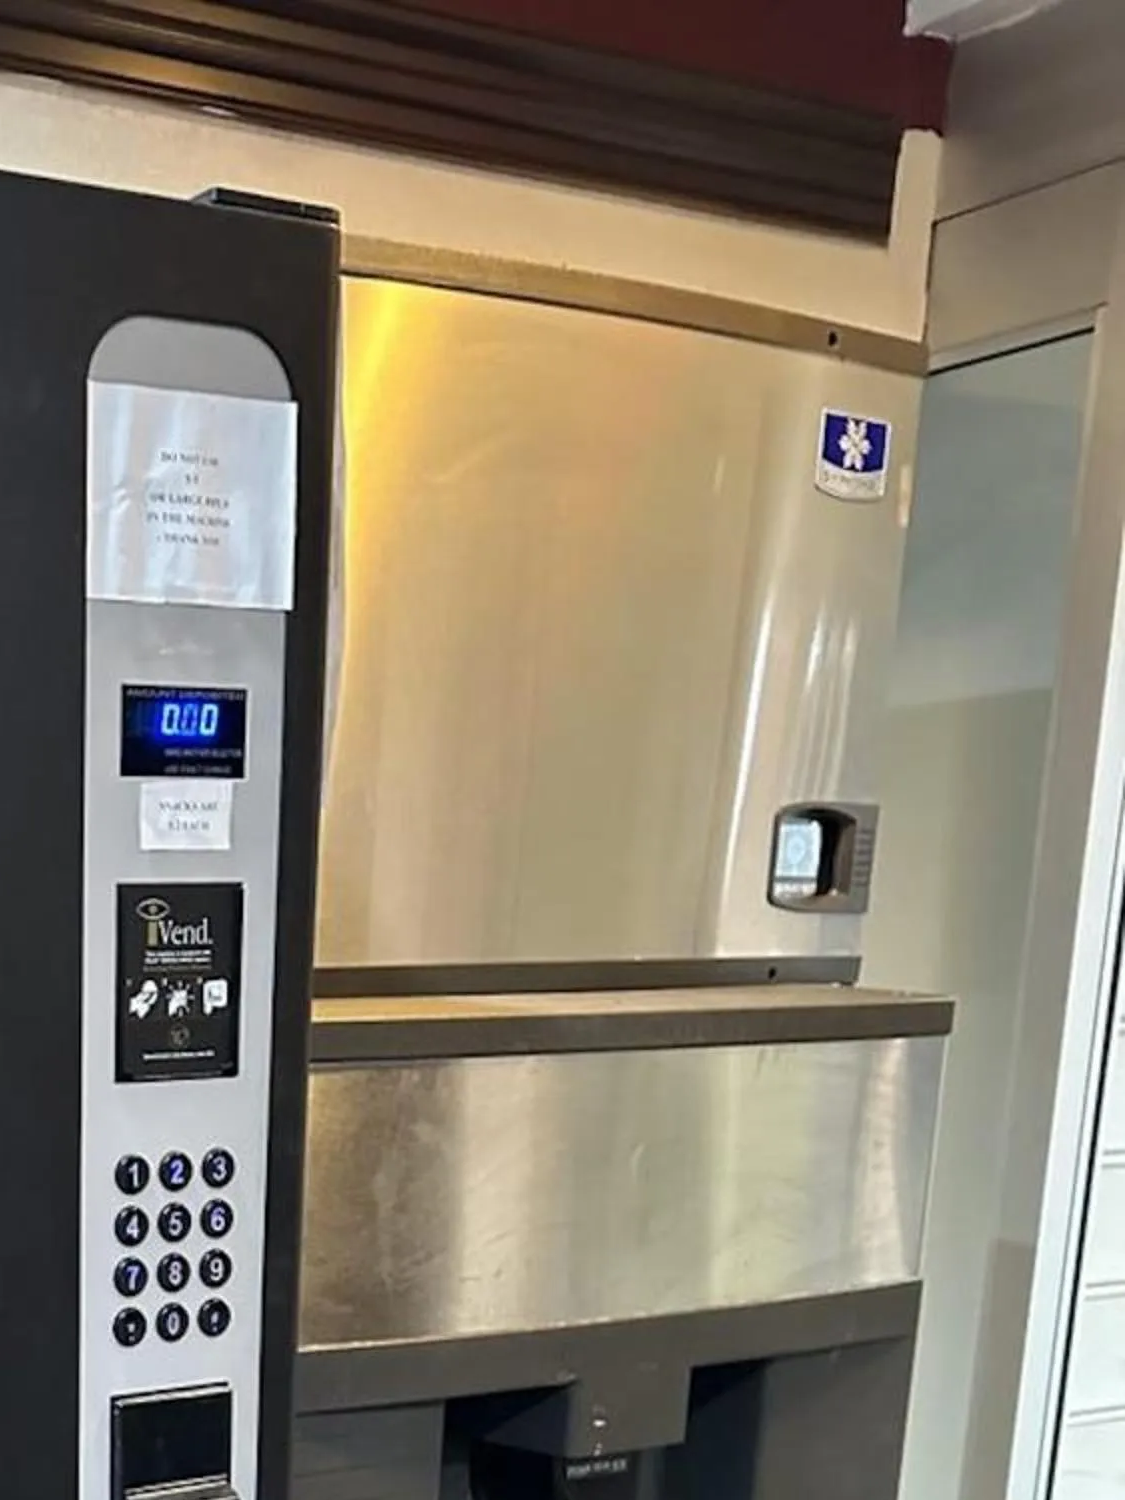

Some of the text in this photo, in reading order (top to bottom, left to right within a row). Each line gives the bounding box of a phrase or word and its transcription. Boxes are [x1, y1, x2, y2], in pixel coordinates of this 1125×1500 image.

[127, 1155, 228, 1188] 1 2 3
[125, 1206, 226, 1239] 4 5 6
[126, 1257, 224, 1291] 7 8 9
[166, 1311, 180, 1336] 0
